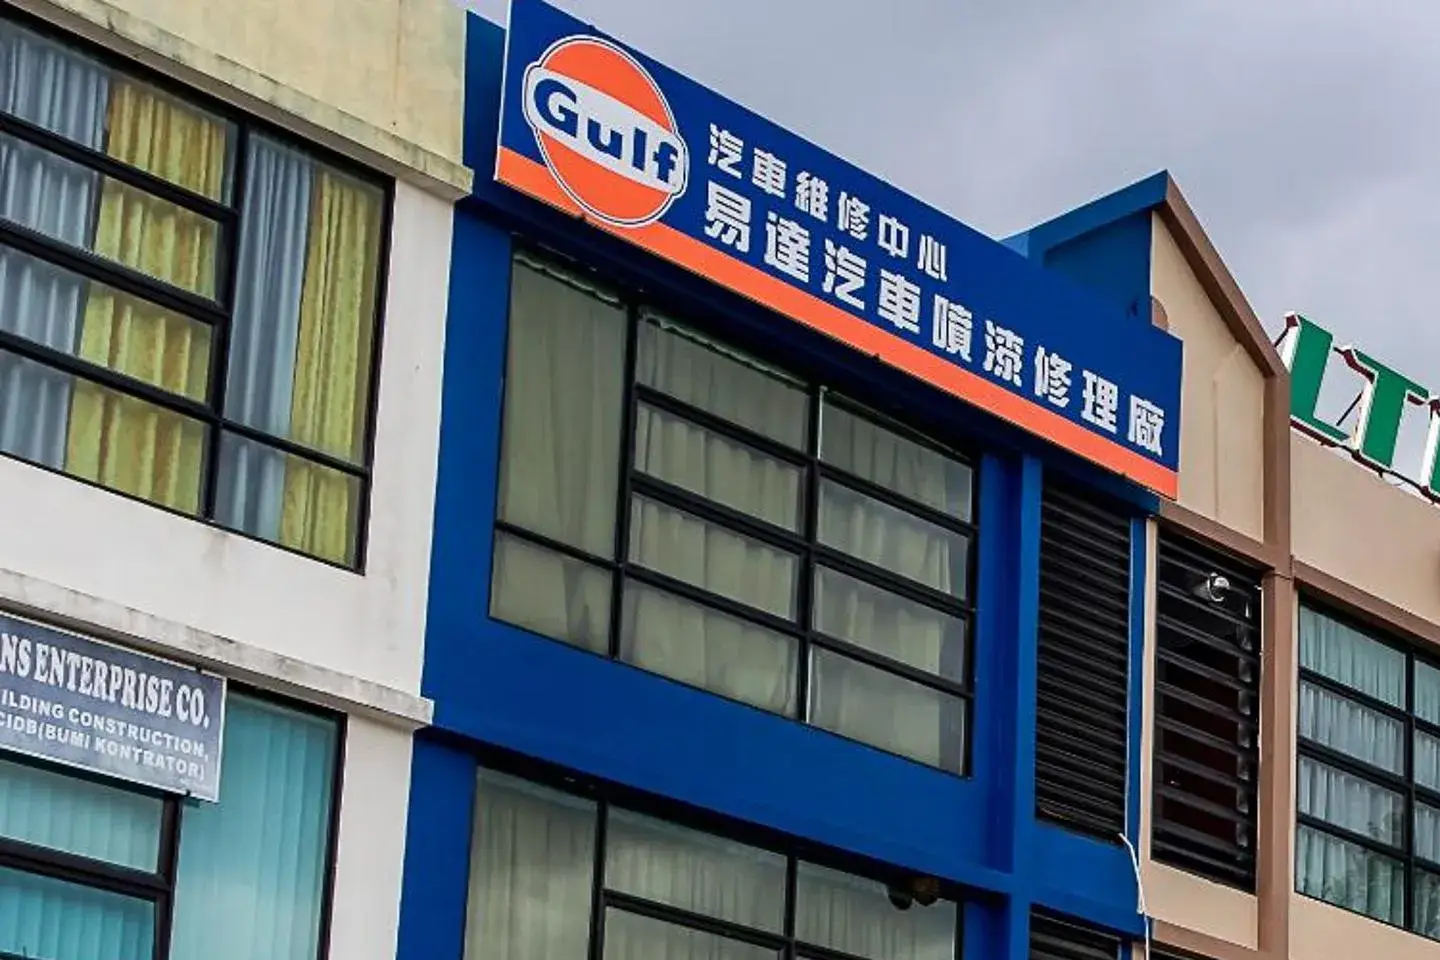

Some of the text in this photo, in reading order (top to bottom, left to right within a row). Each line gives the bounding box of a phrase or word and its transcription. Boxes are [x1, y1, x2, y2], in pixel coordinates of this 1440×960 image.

[533, 78, 679, 183] Gulf
[707, 122, 948, 283] 汽車維修中心
[703, 179, 1165, 458] 易達汽車噴漆修理廠
[34, 642, 174, 718] ENTERPRISE
